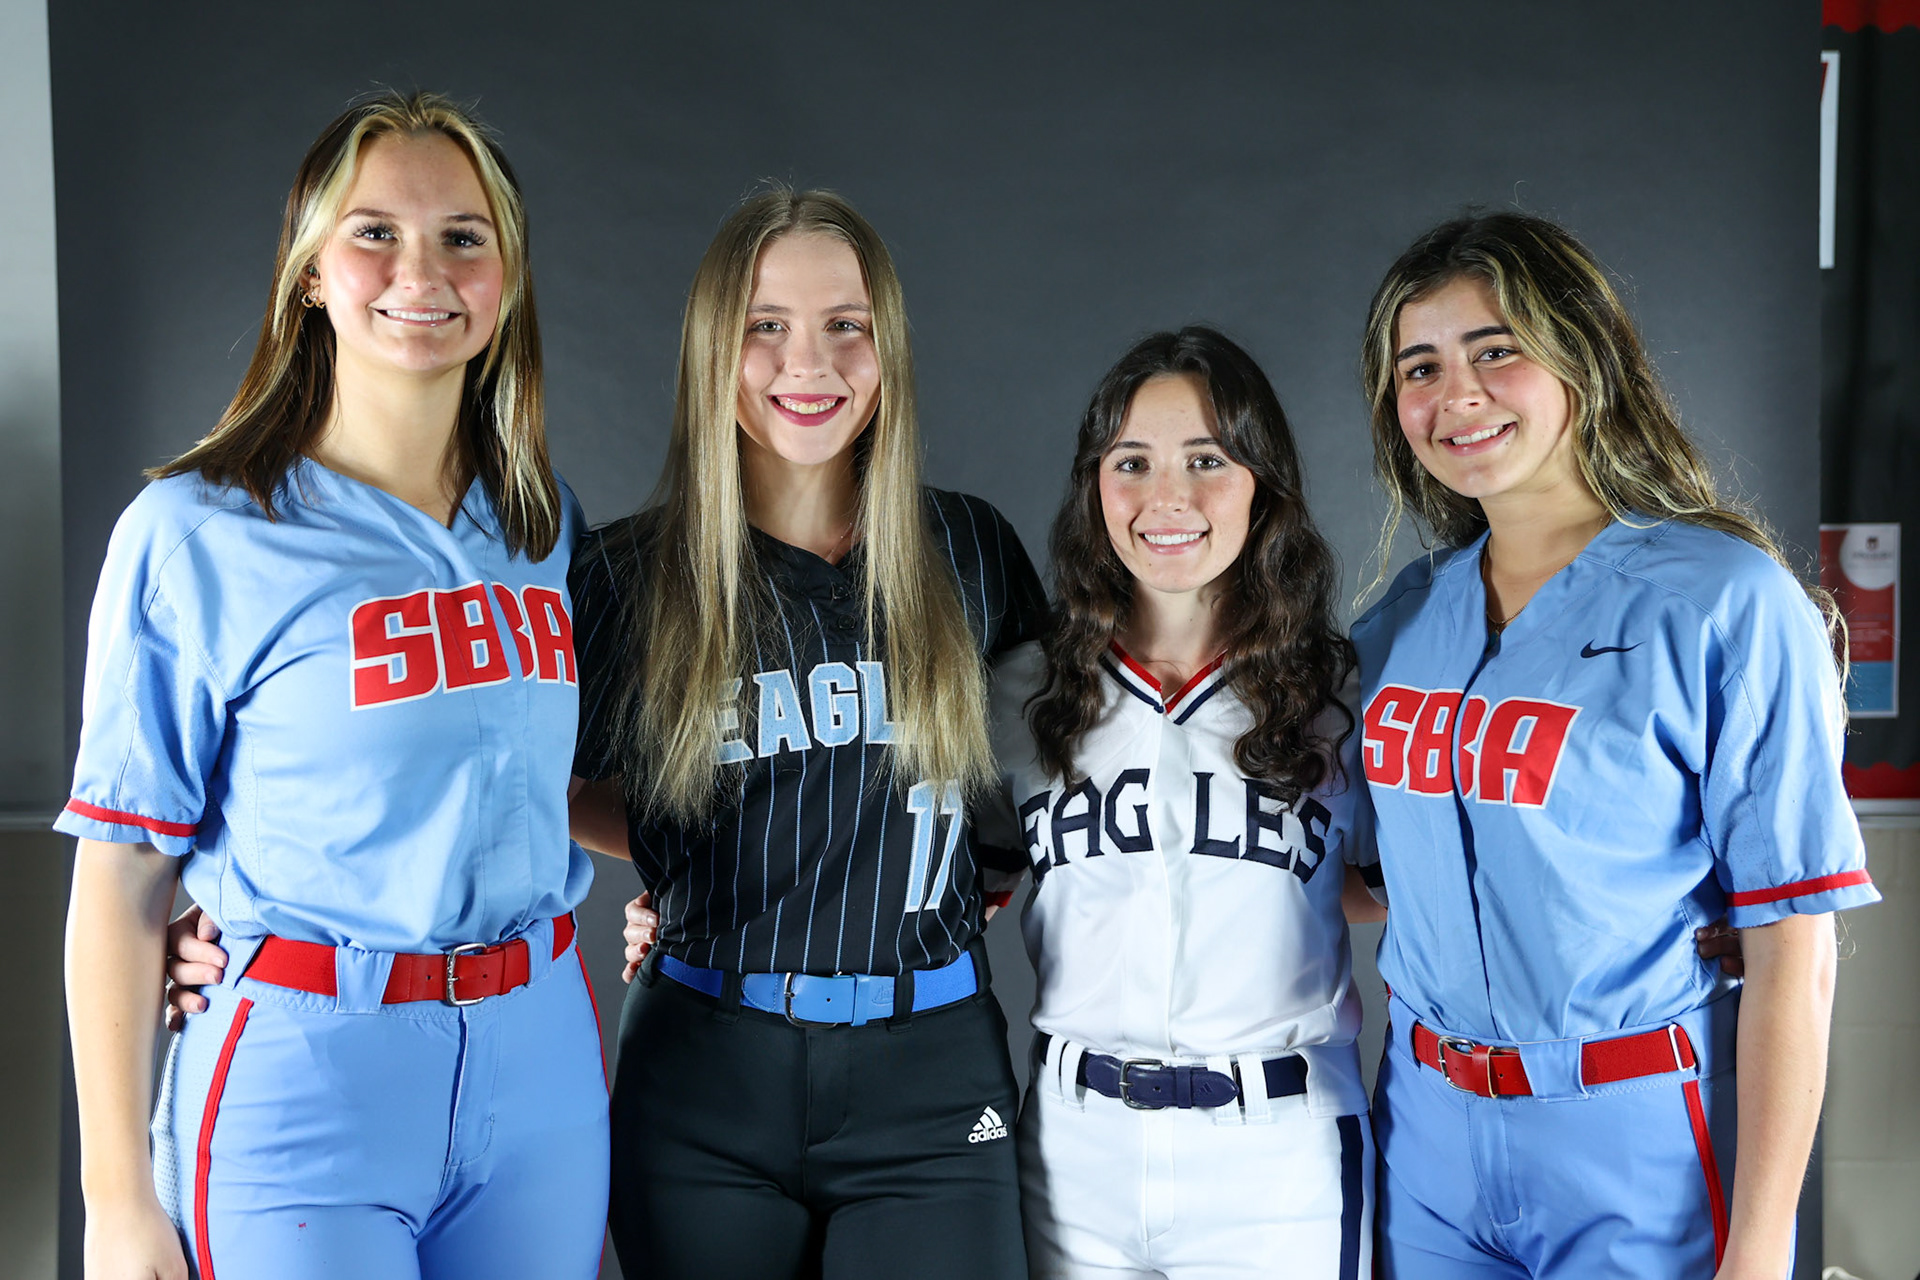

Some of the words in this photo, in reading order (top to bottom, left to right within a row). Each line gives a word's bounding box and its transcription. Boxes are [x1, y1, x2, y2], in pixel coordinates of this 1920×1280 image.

[348, 580, 577, 711] SBA
[713, 661, 918, 765] EAGL
[1363, 683, 1584, 809] SBA
[906, 779, 963, 913] 17
[1018, 768, 1332, 885] EAGLES
[968, 1126, 1008, 1144] adidas
